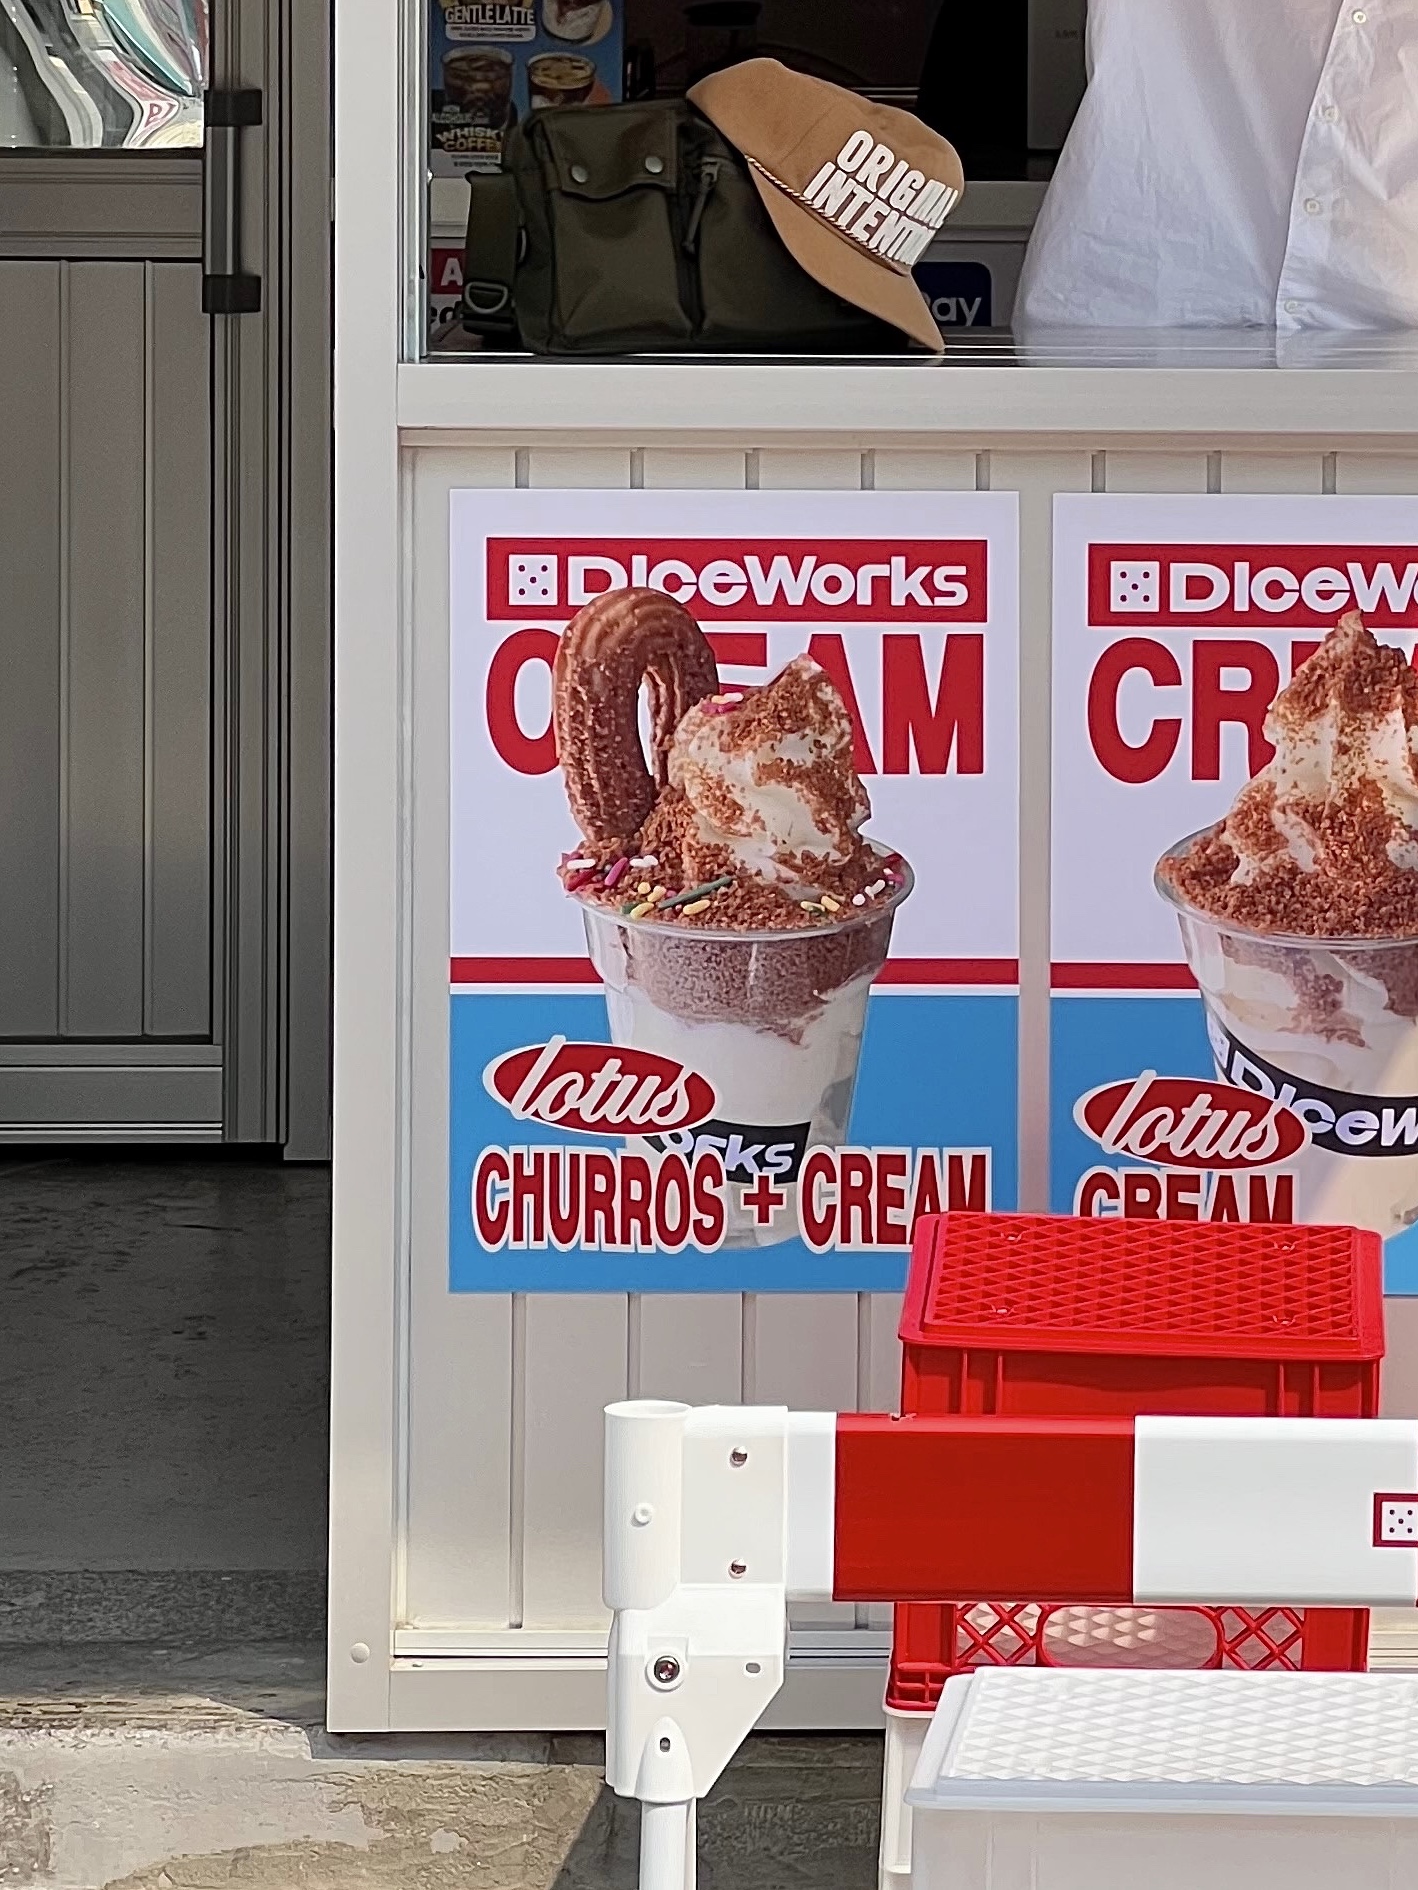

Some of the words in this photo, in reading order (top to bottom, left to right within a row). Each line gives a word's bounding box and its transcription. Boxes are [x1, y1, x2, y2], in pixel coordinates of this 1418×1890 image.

[445, 5, 494, 24] GENTLE
[495, 6, 535, 25] LATTE
[474, 1148, 727, 1250] CHURROS
[800, 1149, 992, 1249] CREAM
